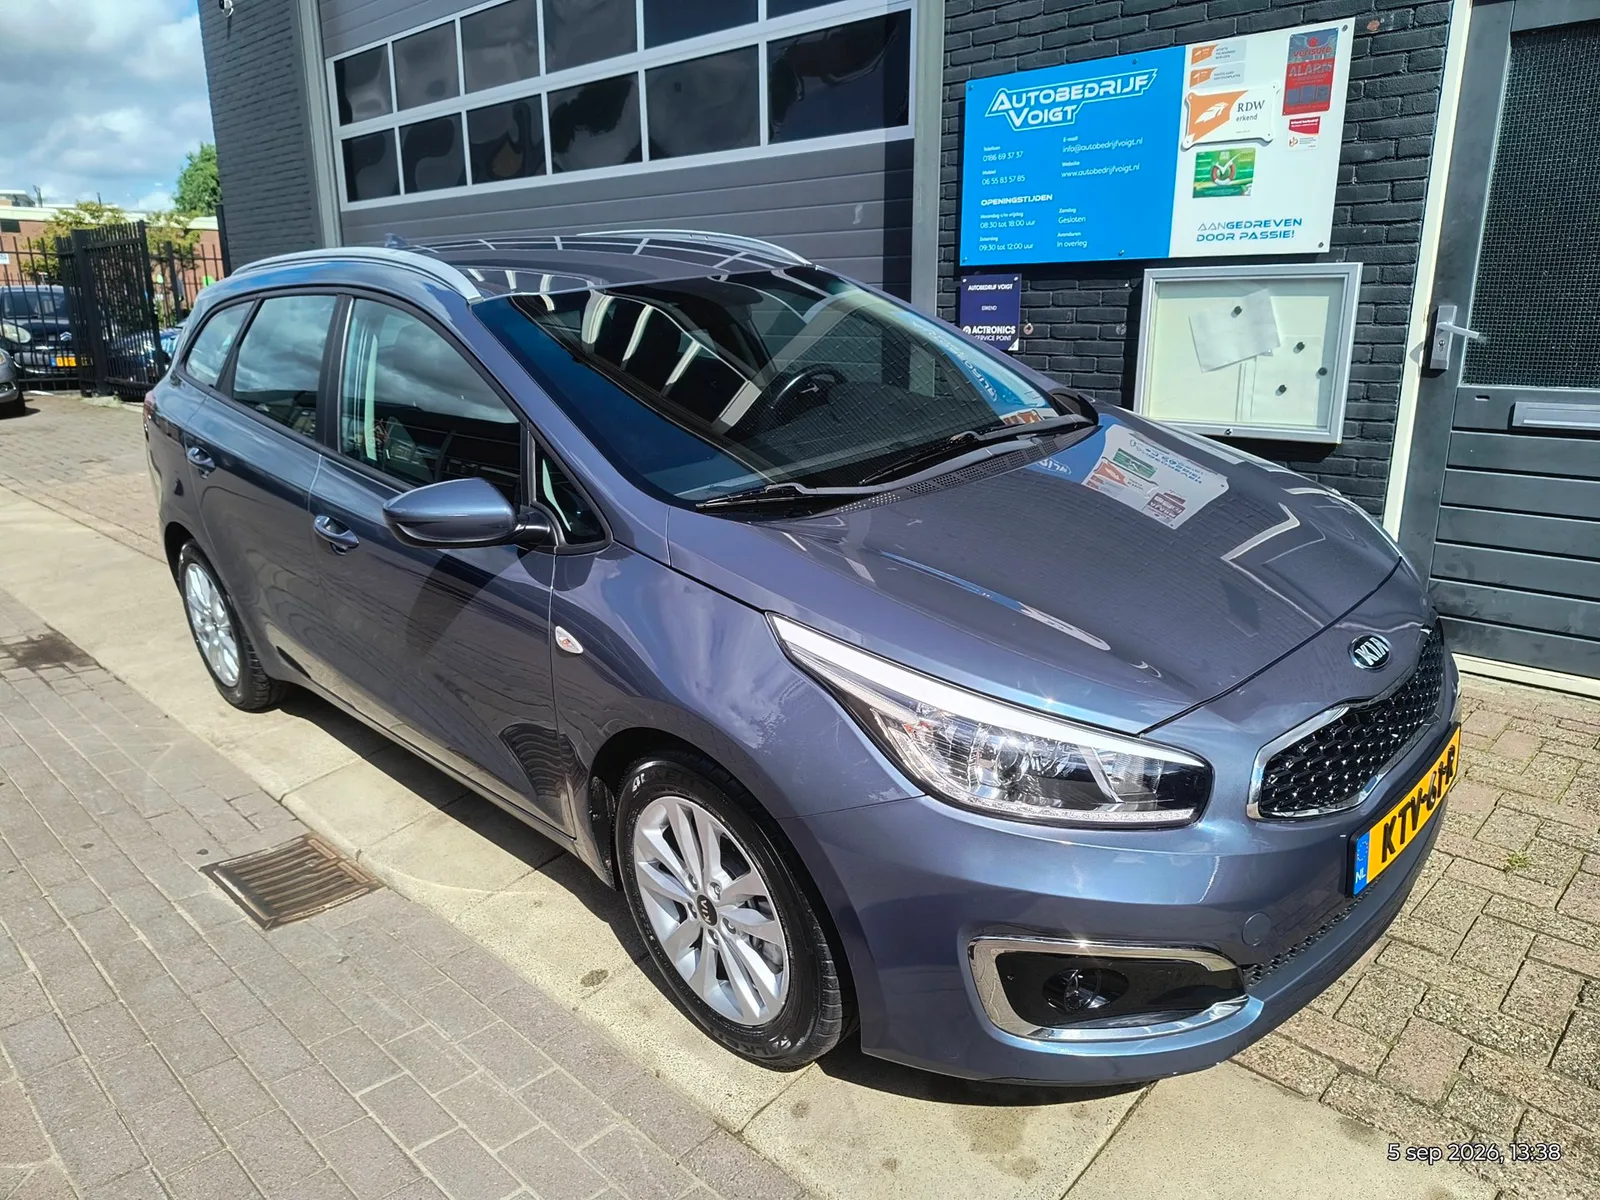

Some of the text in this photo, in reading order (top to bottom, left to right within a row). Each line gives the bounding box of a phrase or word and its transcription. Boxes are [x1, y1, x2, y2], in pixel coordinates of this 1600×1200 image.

[1288, 63, 1332, 77] ALARM
[991, 74, 1150, 111] AUTOBEDRIJF
[1237, 99, 1265, 112] RDW
[1008, 104, 1077, 127] VOIGT
[1235, 113, 1258, 122] erkend
[1062, 137, 1144, 153] info@autobedrijfvoigt.nl
[997, 152, 1007, 161] 69
[1007, 151, 1016, 160] 37
[1016, 150, 1024, 159] 37
[1061, 163, 1141, 177] www.autobedrijfvoigt.nl
[981, 178, 991, 186] 06
[999, 176, 1008, 184] 83
[1017, 174, 1026, 182] 85
[980, 193, 1053, 206] OPENINGSTIJDEN
[1058, 216, 1087, 224] Gesloten
[1197, 218, 1303, 232] AANGEDREVEN
[1196, 230, 1295, 242] DOOR PASSIE!
[1063, 240, 1088, 249] overleg
[971, 325, 1016, 335] ACTRONICS
[1354, 636, 1390, 666] KIA
[1355, 867, 1367, 884] NL
[700, 899, 712, 924] KIA
